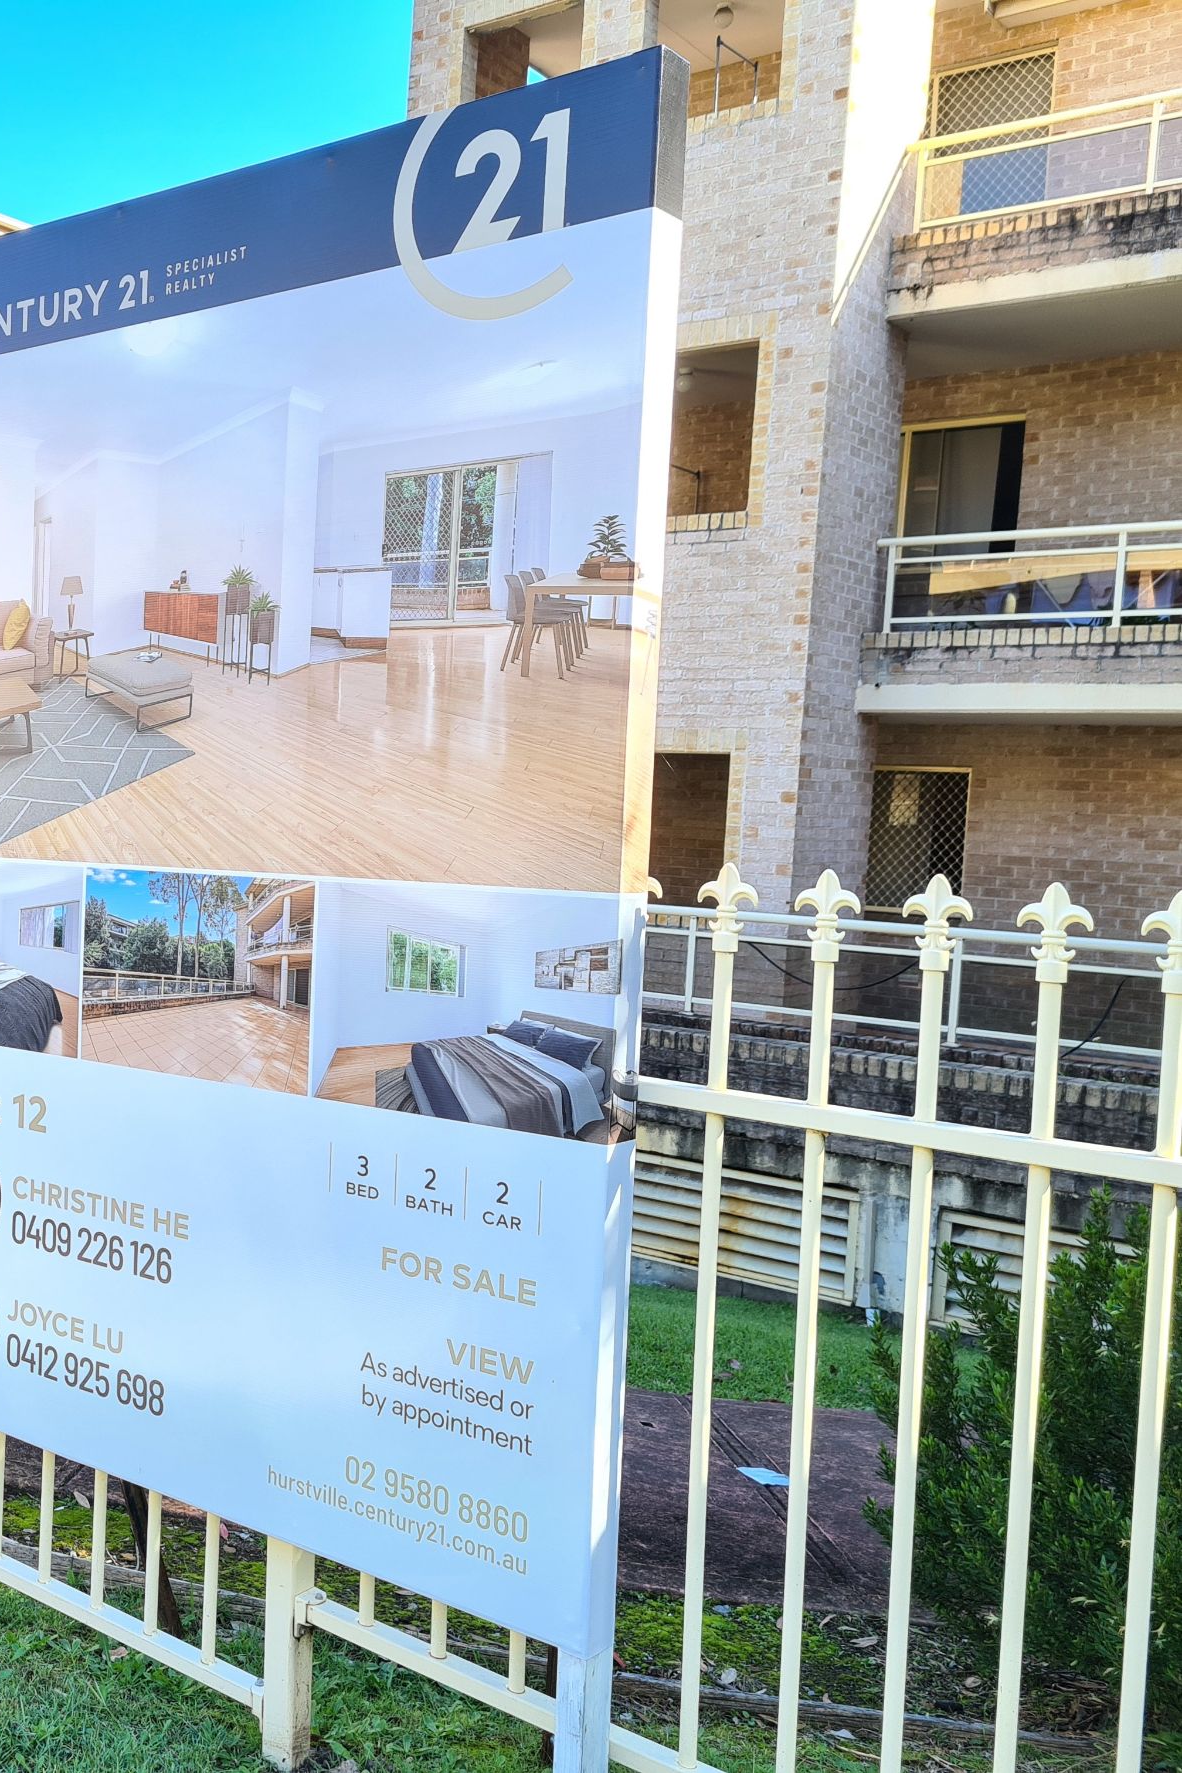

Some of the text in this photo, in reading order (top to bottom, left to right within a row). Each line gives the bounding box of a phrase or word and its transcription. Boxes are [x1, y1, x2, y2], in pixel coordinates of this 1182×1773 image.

[165, 272, 215, 296] REALTY
[166, 246, 247, 277] SPECIALIST
[12, 1094, 47, 1133] 12
[356, 1155, 369, 1177] 3
[424, 1168, 437, 1190] 2
[12, 1175, 190, 1240] CHRISTINE HE
[346, 1181, 379, 1200] BED
[405, 1194, 453, 1217] BATH
[496, 1181, 509, 1205] 2
[482, 1211, 522, 1231] CAR
[11, 1210, 172, 1284] 0409 226 126
[381, 1246, 537, 1307] FOR SALE
[7, 1299, 124, 1354] JOYCE LU
[6, 1333, 165, 1417] 0412 925 698
[446, 1338, 534, 1385] VIEW
[360, 1351, 534, 1420] As advertised or
[361, 1383, 533, 1457] by appointment
[267, 1464, 527, 1576] hurstville.century21.com.au
[345, 1456, 528, 1543] 02 9580 8860
